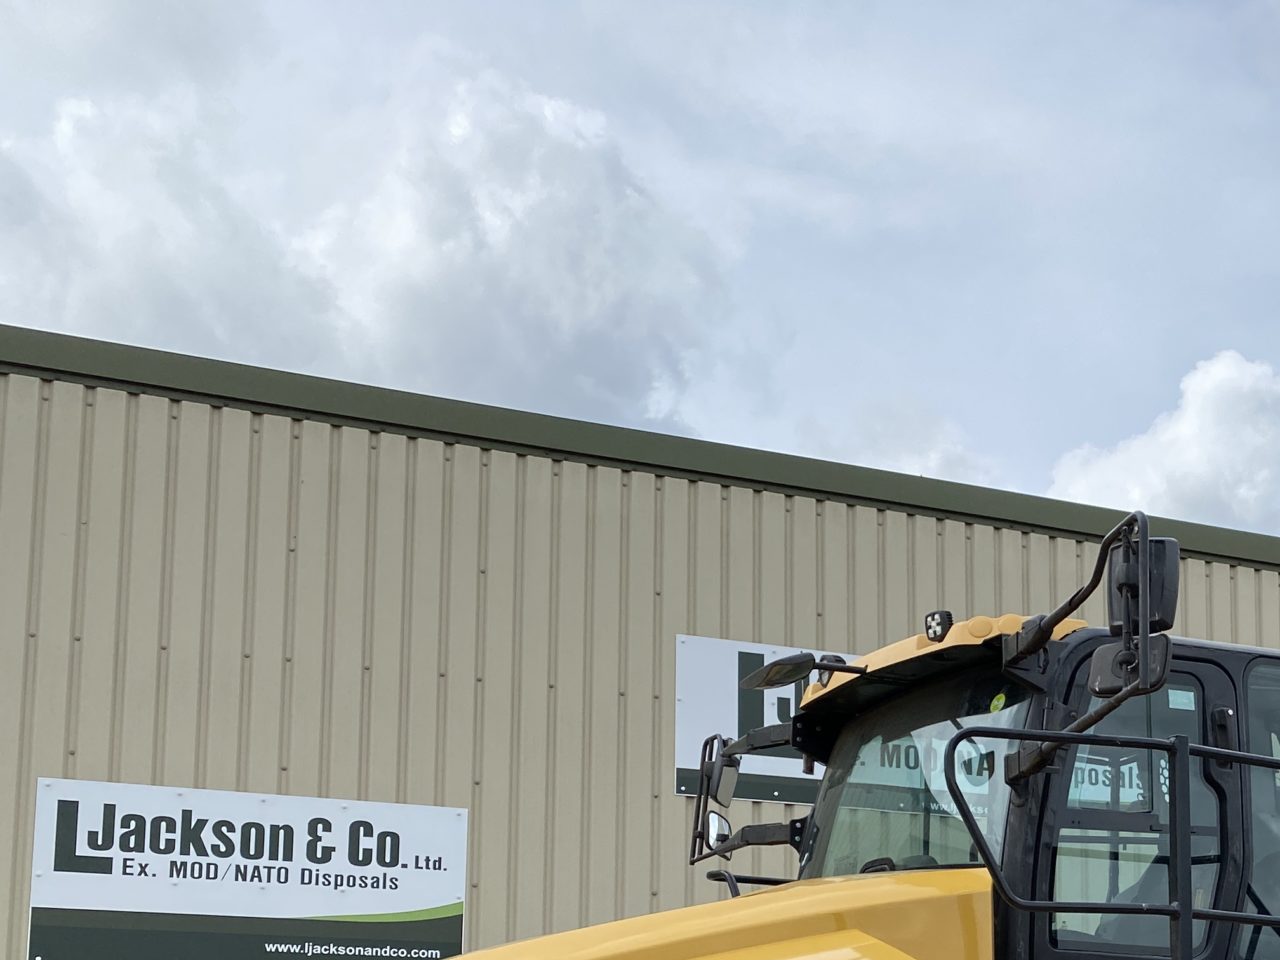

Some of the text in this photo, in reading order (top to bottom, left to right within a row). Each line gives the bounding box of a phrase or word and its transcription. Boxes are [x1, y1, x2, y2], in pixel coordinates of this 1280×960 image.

[306, 817, 336, 865] &
[347, 820, 408, 868] Co.
[414, 855, 448, 872] Ltd.
[121, 857, 399, 891] Ex. MOD/NATO Disposals
[264, 942, 441, 959] www.ljacksonandco.com
